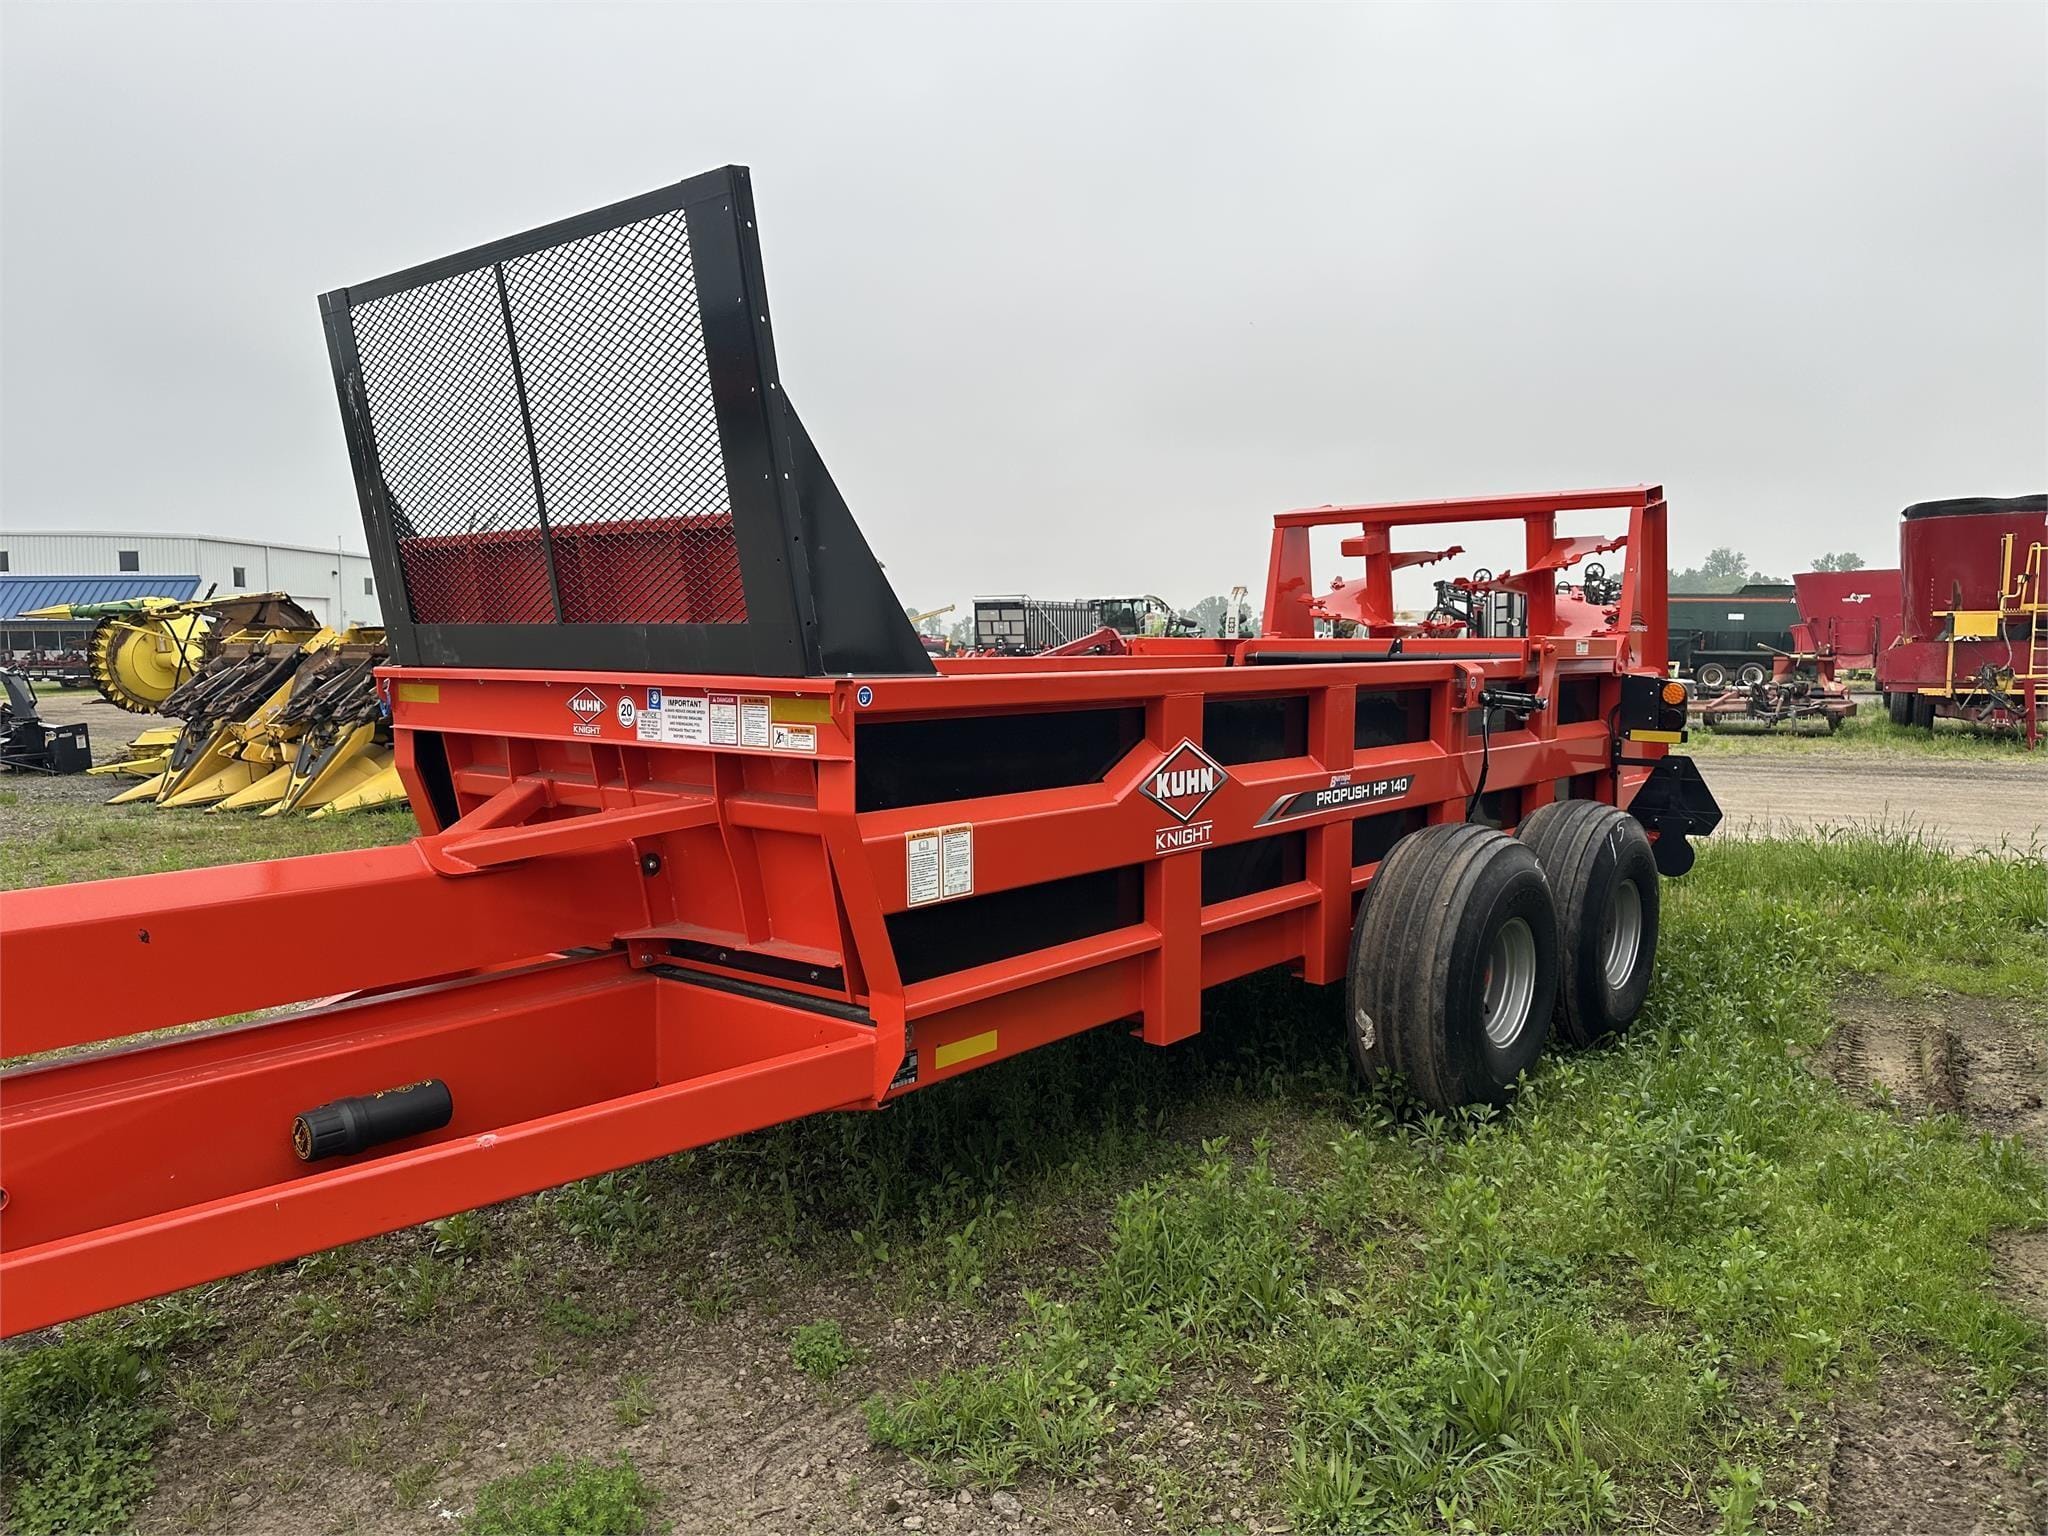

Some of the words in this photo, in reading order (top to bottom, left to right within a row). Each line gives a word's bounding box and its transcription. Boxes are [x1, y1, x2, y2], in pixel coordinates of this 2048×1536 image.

[572, 699, 602, 714] KUHN
[620, 703, 633, 717] 20
[668, 700, 702, 708] IMPORTANT
[573, 725, 601, 736] KNIGHT
[1156, 767, 1214, 799] KUHN
[1316, 784, 1370, 806] PROPUSH
[1373, 781, 1388, 797] HP
[1391, 778, 1407, 793] 140
[1156, 825, 1213, 850] KNIGHT
